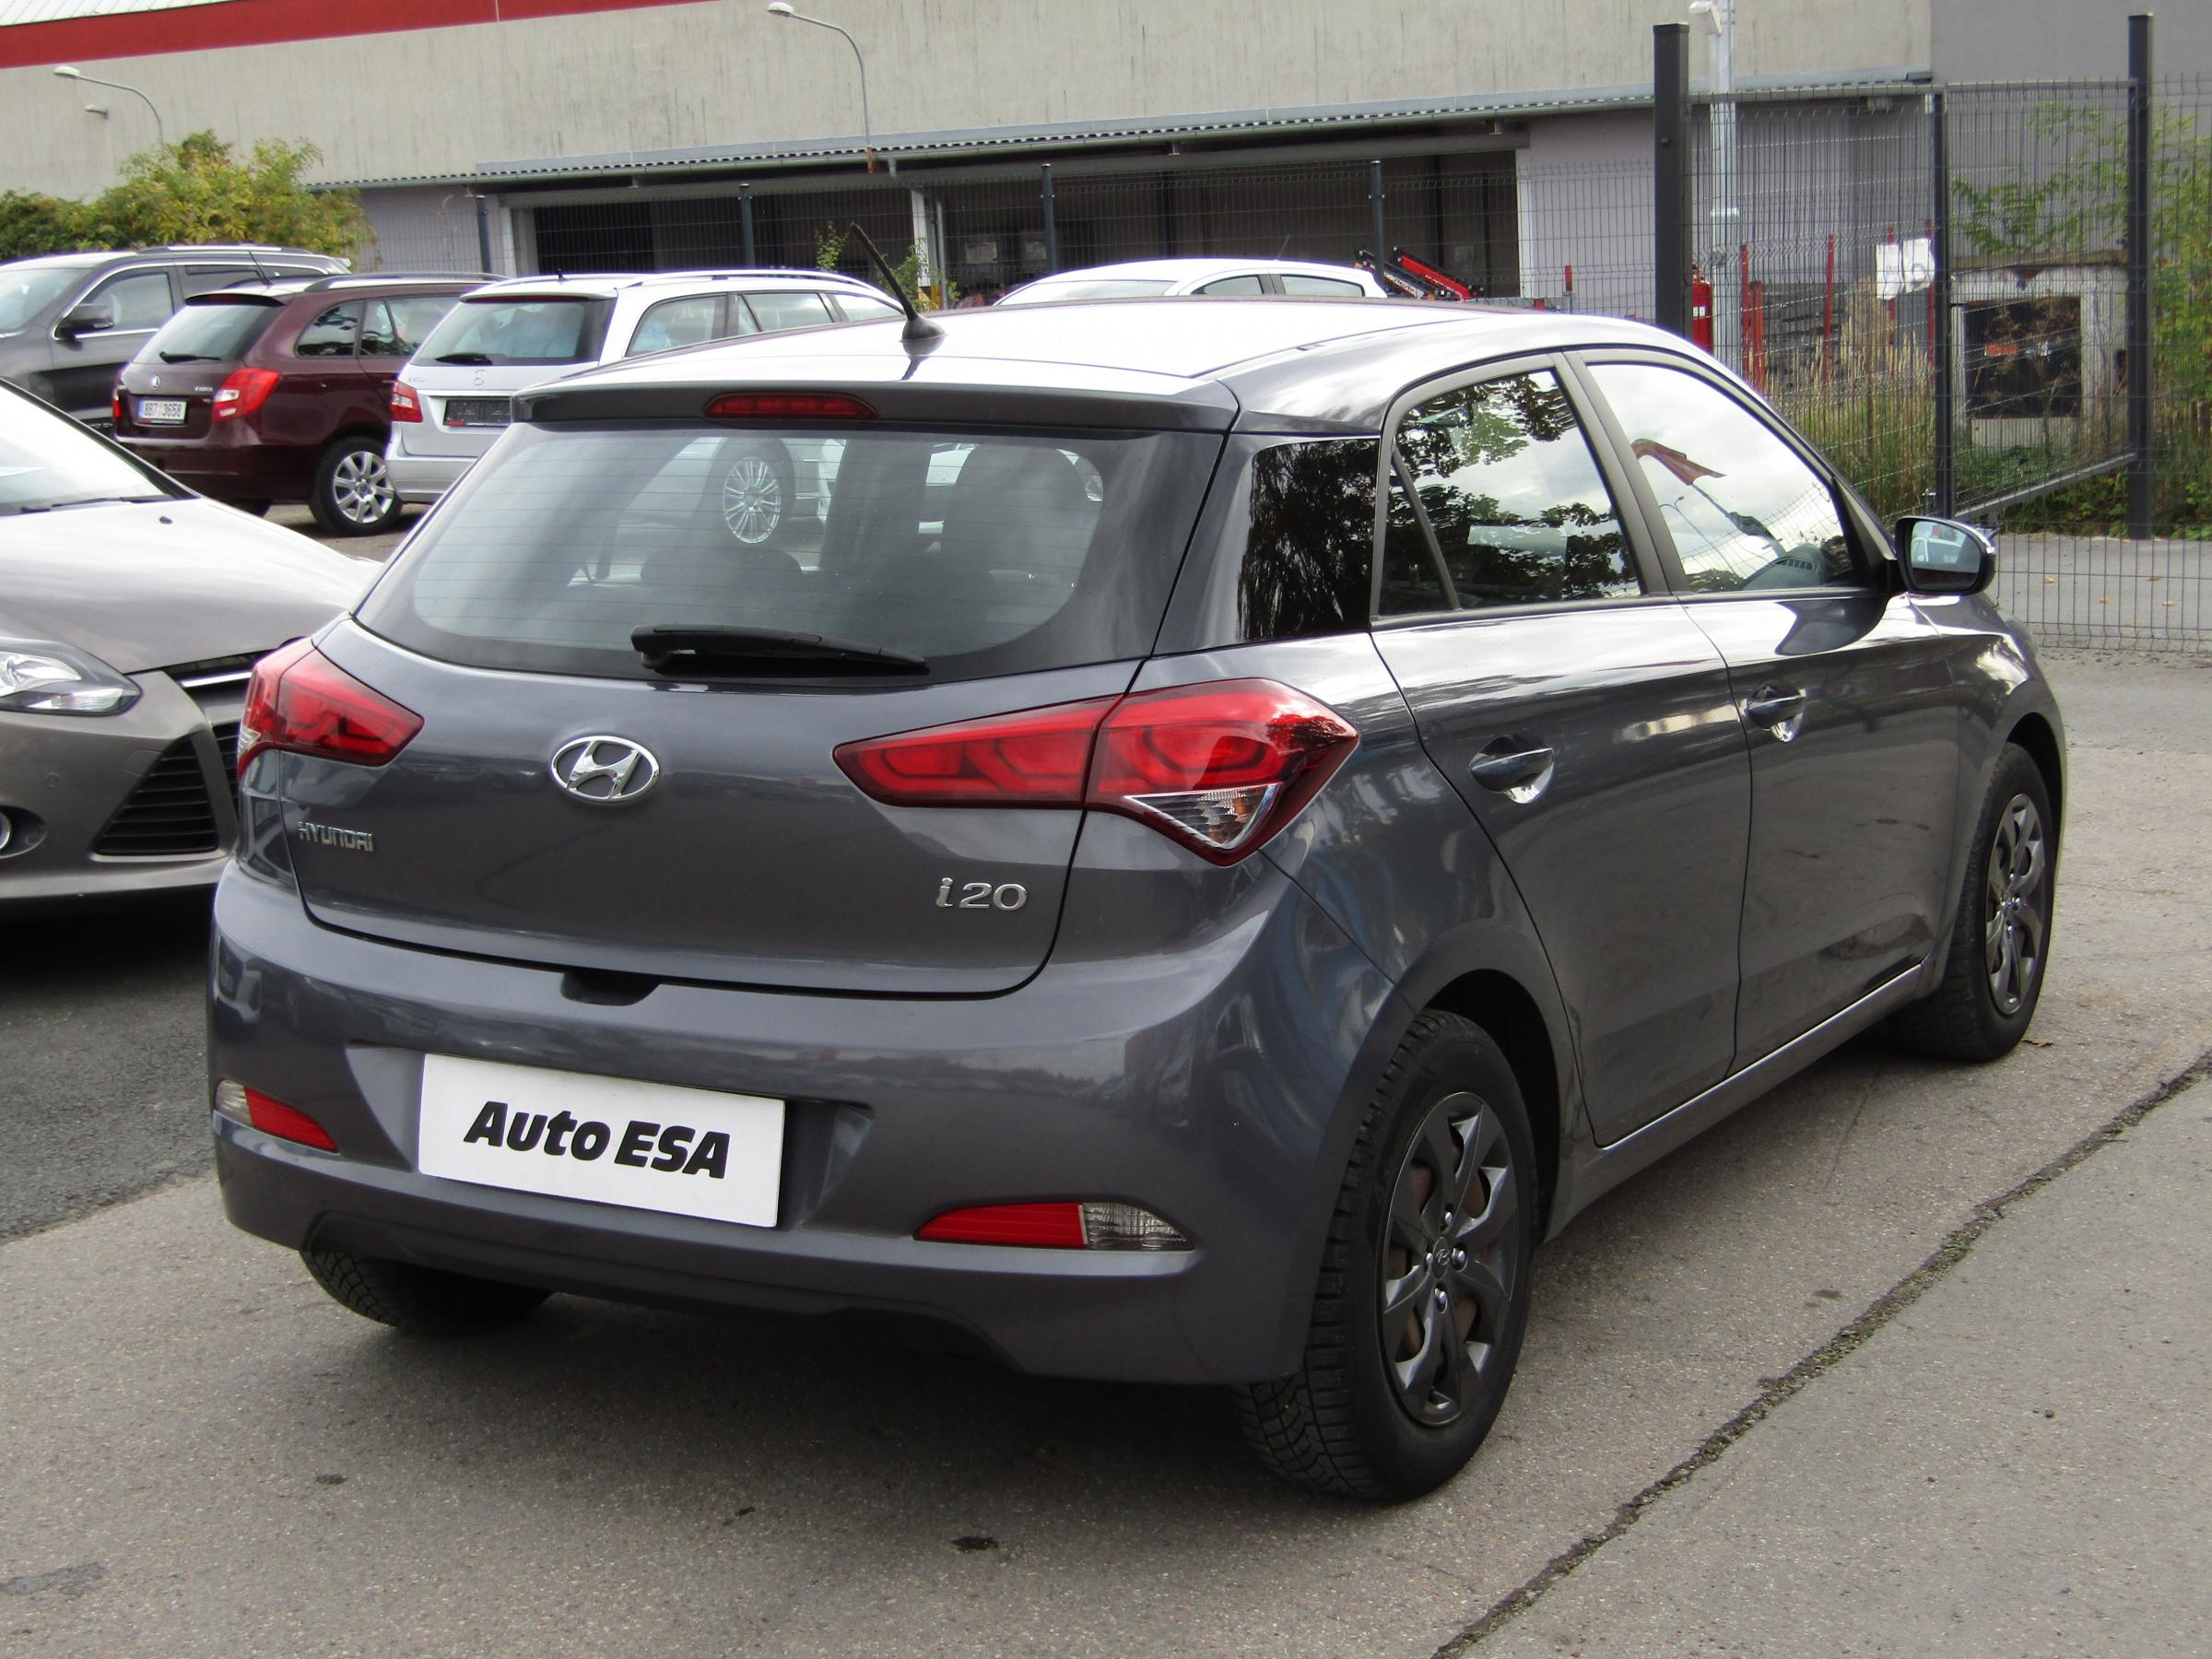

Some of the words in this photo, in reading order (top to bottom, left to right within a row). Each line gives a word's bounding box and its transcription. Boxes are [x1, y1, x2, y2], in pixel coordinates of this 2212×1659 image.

[297, 821, 374, 853] HYUNDAI
[935, 877, 1028, 912] i20
[463, 1100, 611, 1161] Auto
[614, 1120, 731, 1180] ESA
